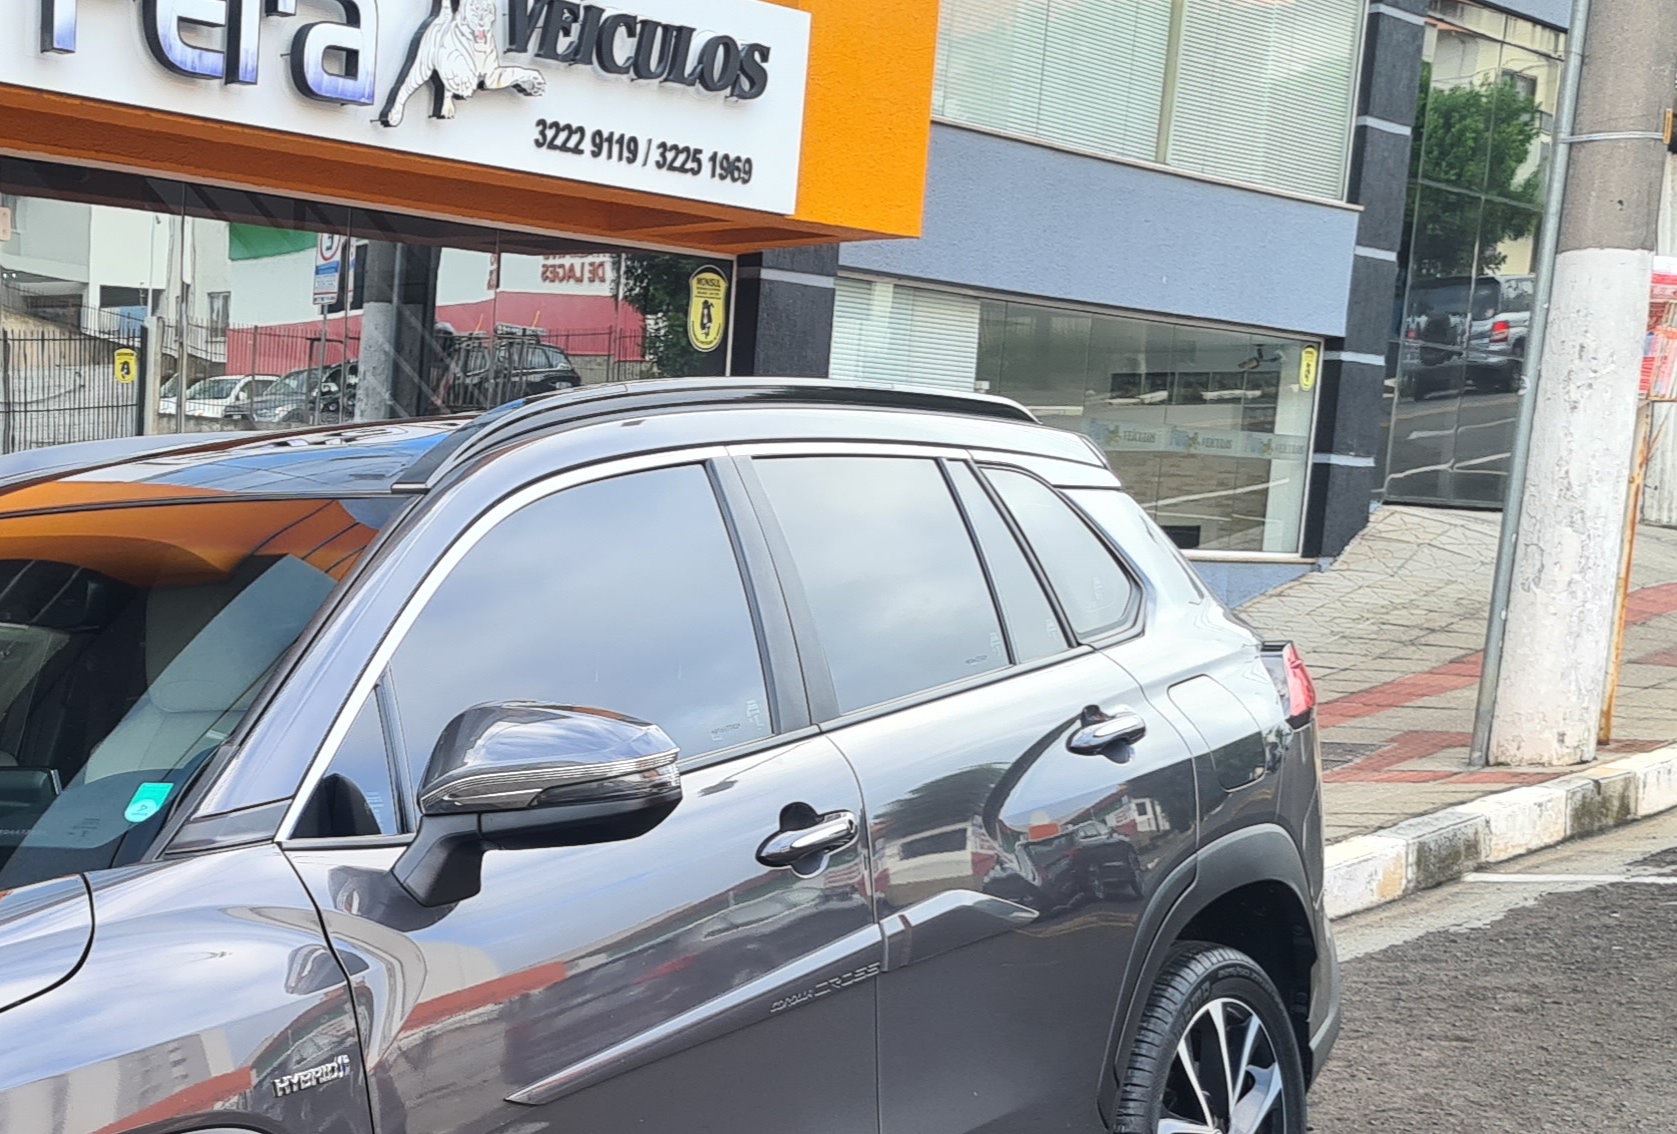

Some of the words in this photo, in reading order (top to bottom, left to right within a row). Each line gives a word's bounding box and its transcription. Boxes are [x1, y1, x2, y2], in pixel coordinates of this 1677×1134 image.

[533, 118, 586, 154] 3222
[590, 129, 639, 164] 9119
[642, 139, 652, 166] /
[654, 141, 703, 176] 3225
[708, 151, 753, 184] 1969
[814, 961, 880, 997] CROSS
[271, 1061, 344, 1099] HYBRID
